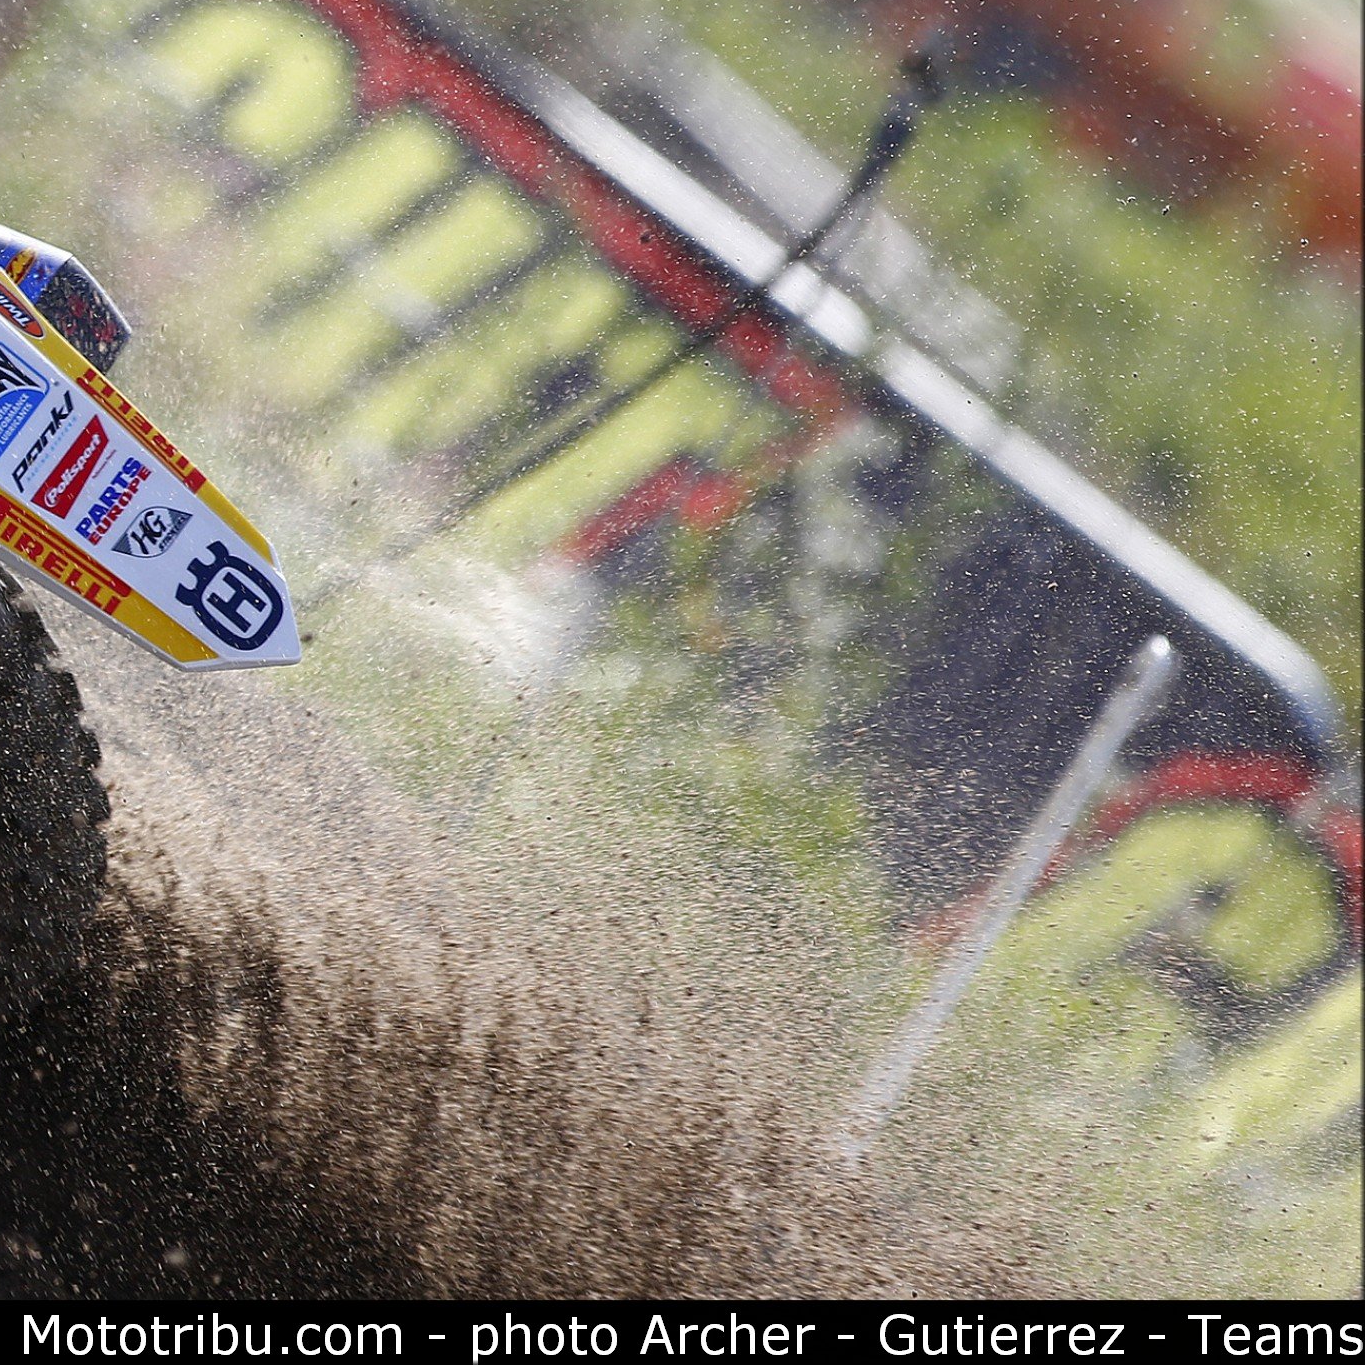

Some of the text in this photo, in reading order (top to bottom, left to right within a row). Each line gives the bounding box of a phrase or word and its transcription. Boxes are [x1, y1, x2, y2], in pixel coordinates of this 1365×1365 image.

[43, 433, 103, 508] Polisport
[74, 456, 143, 539] PARTS
[87, 465, 152, 546] EUROPE
[130, 510, 169, 555] HG
